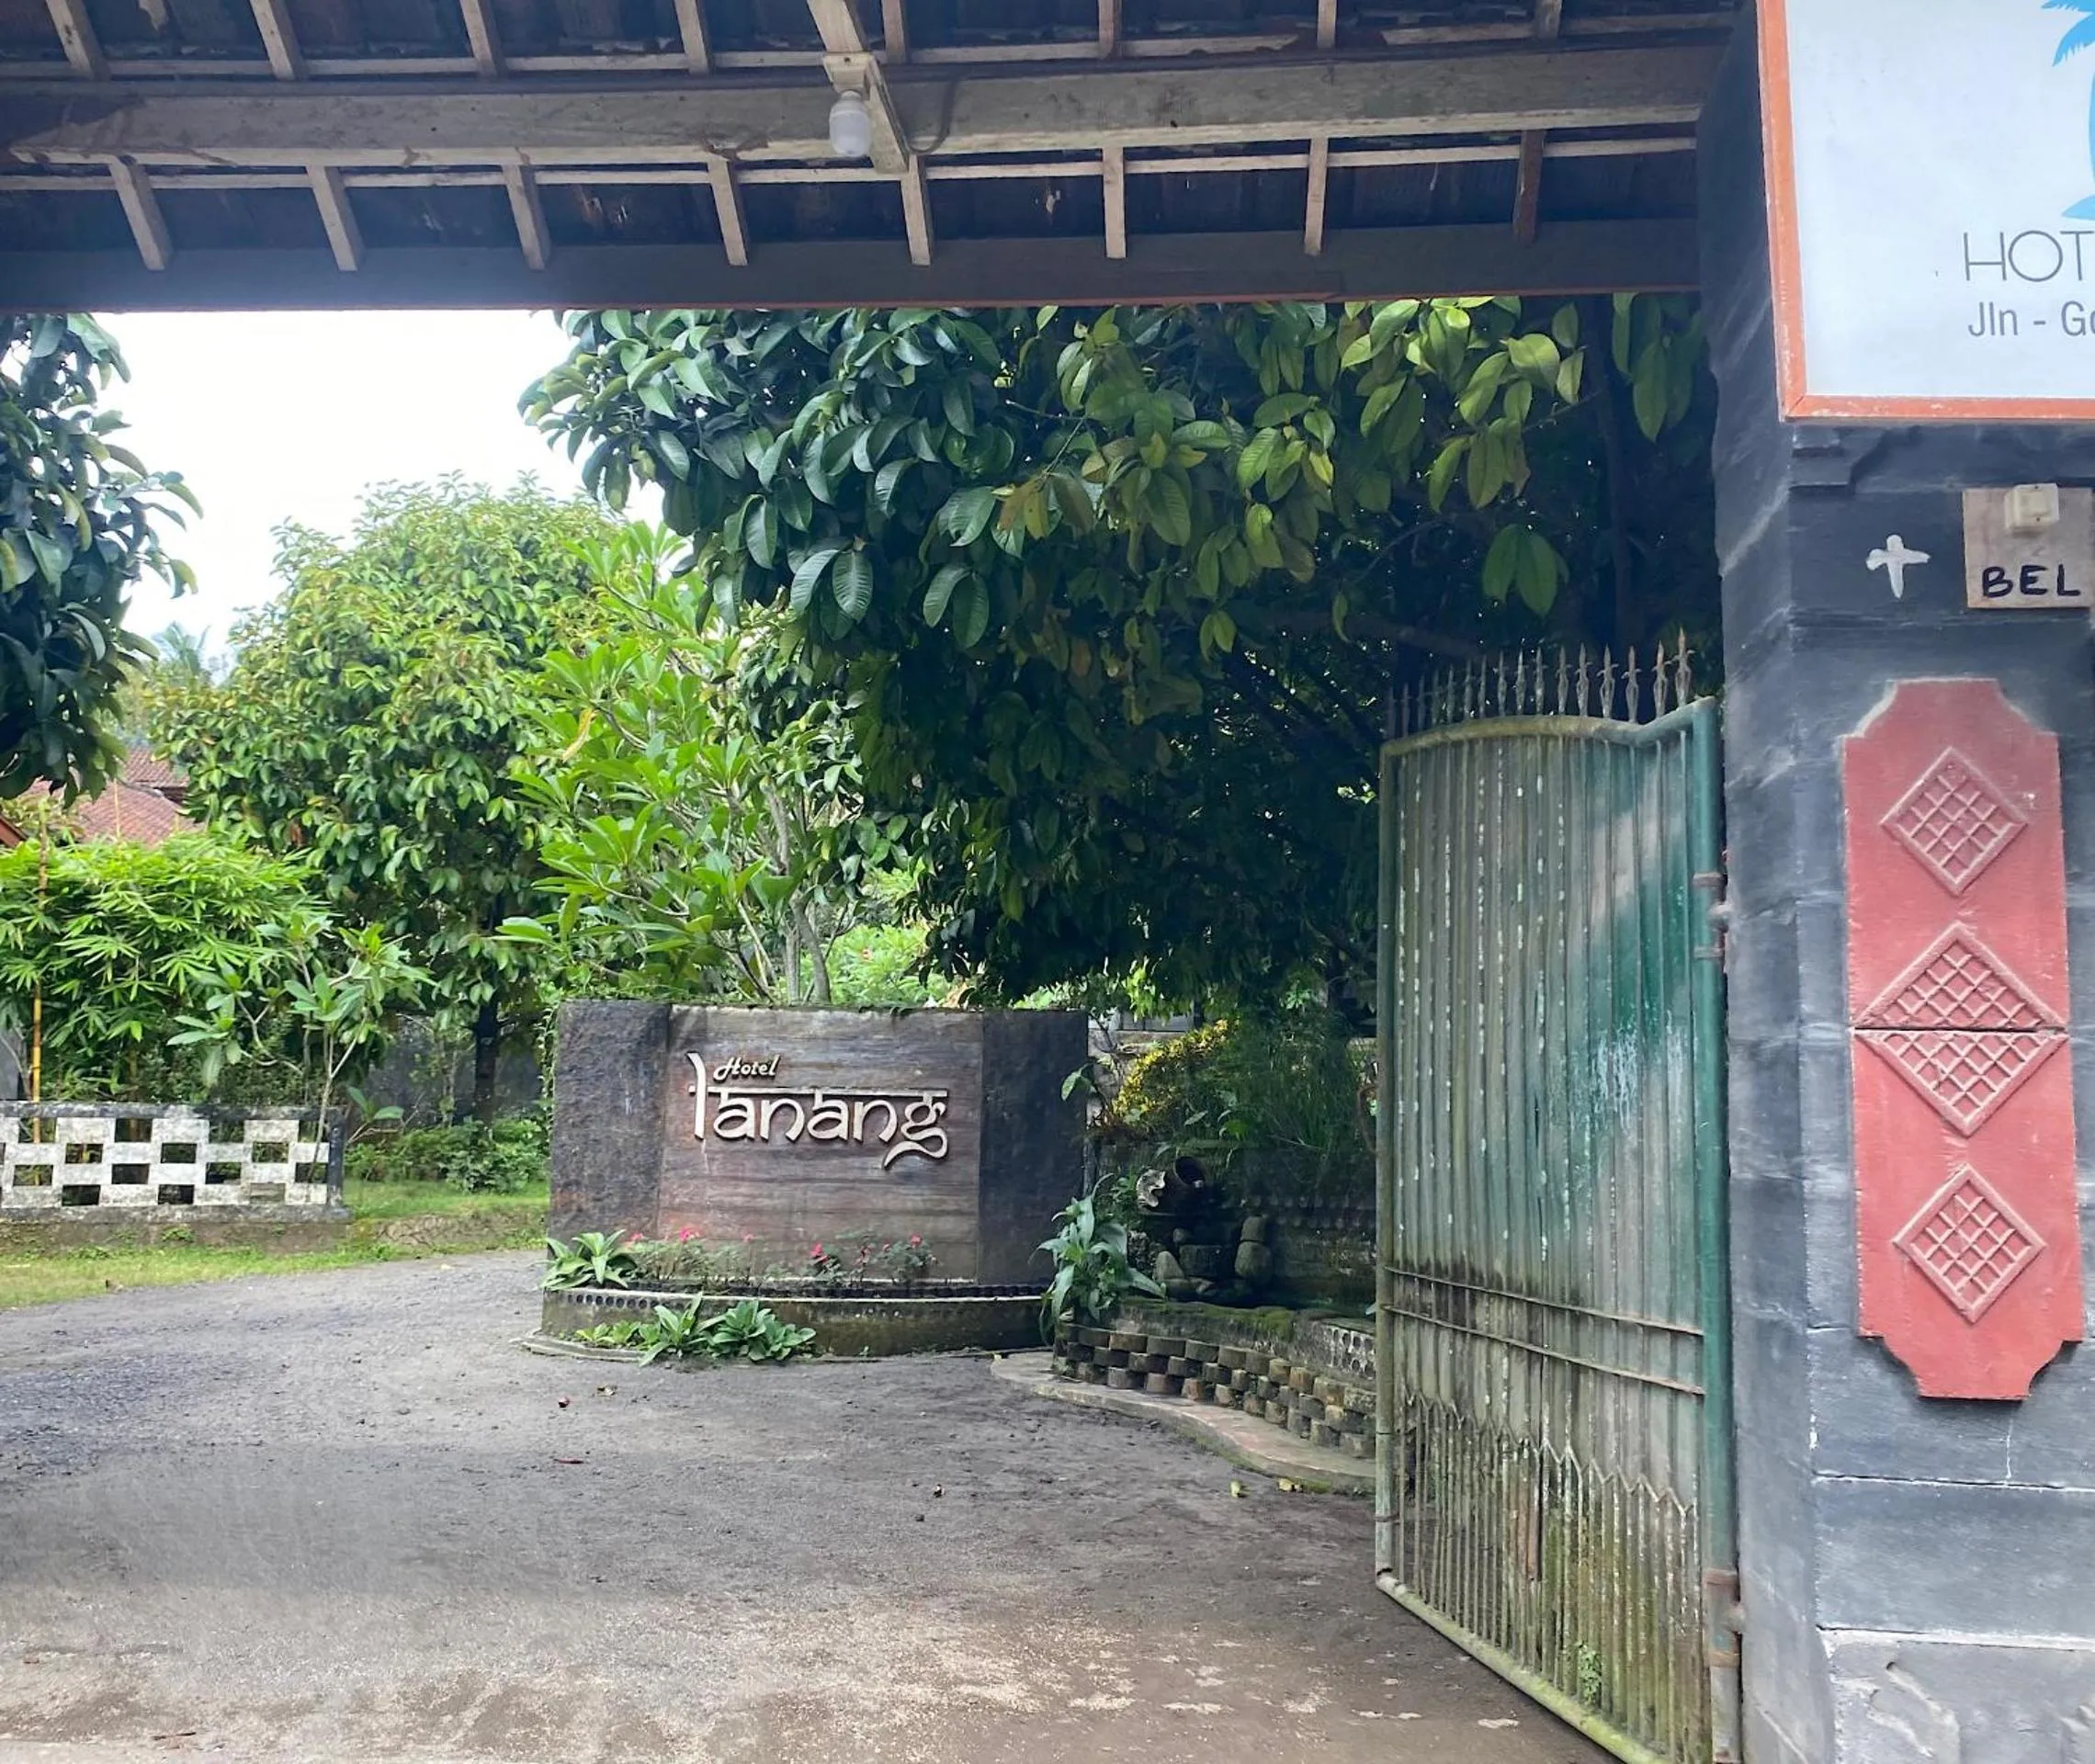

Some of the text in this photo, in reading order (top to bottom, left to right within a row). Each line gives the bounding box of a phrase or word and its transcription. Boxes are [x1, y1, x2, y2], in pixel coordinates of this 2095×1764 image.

[1963, 230, 2094, 282] HOT
[1968, 301, 2018, 336] Jln
[1982, 563, 2081, 598] BEL
[713, 1054, 780, 1081] Hotel
